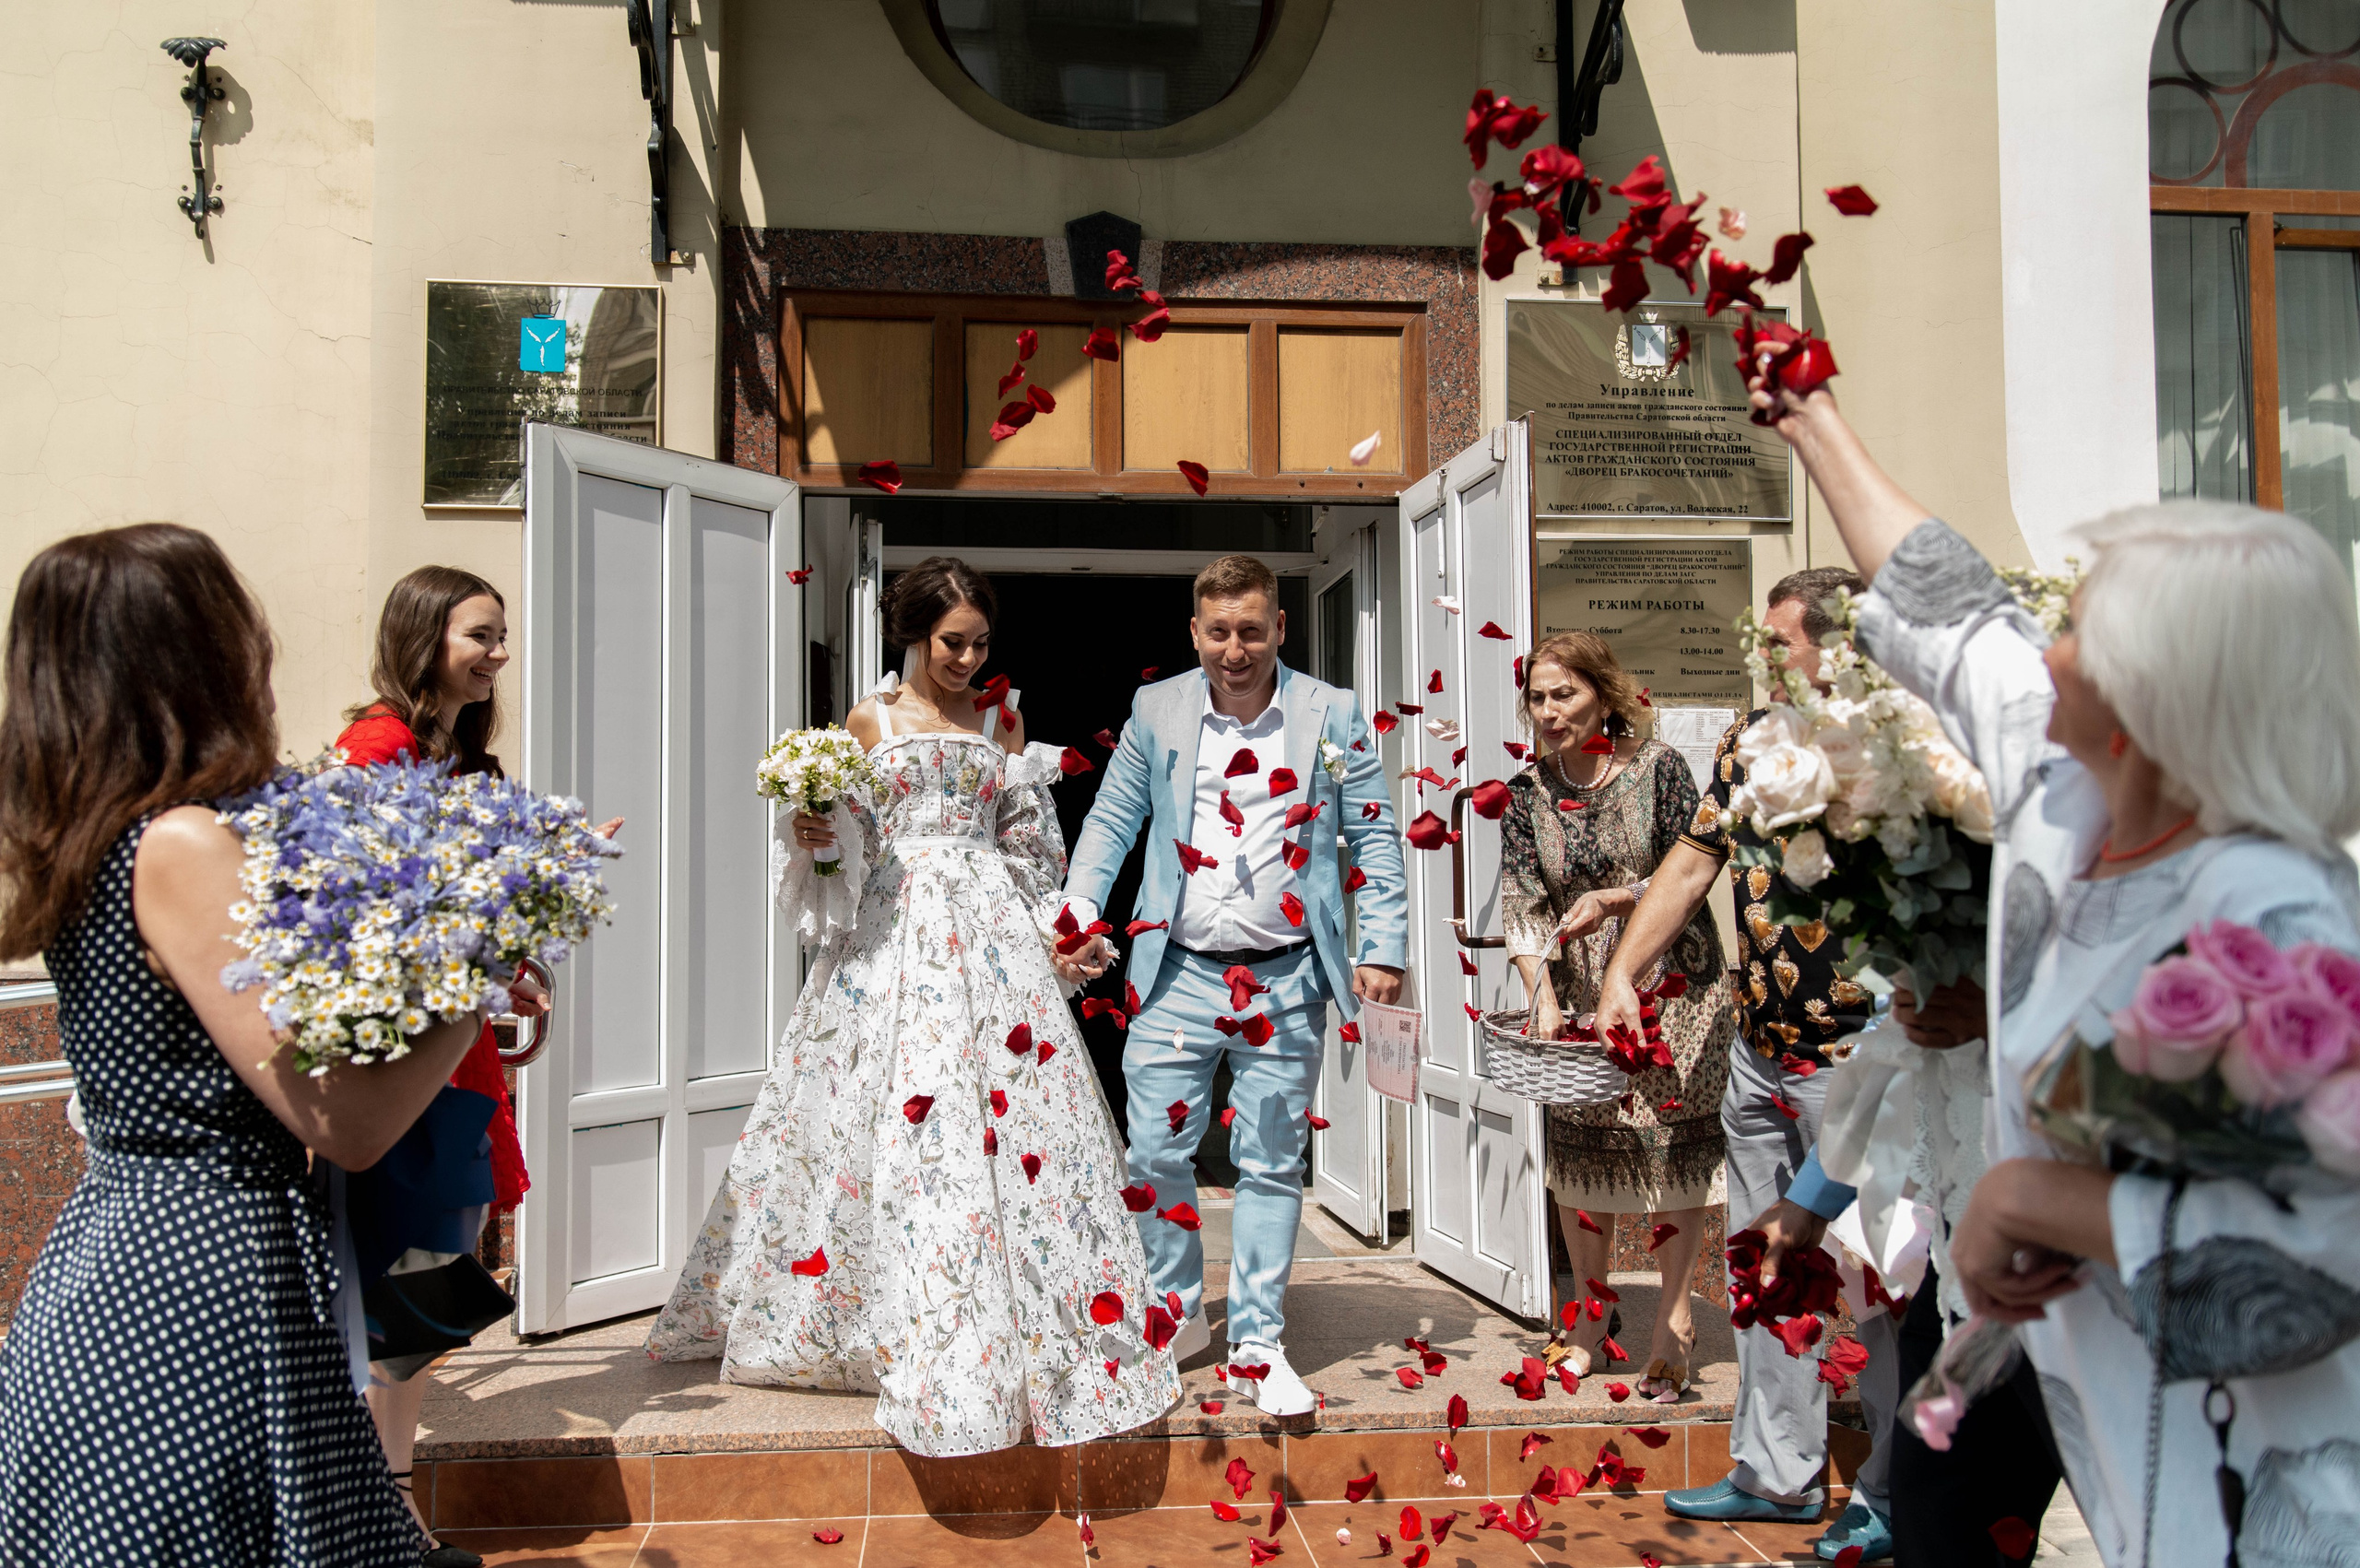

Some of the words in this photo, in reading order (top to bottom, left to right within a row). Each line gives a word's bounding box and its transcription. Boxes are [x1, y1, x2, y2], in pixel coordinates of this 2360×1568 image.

[443, 385, 525, 395] ПРАВИТЕЛЬСТВО
[526, 386, 596, 396] САРАТОВСКОЙ
[597, 387, 643, 397] ОБЛАСТИ
[1600, 383, 1694, 398] Управление
[457, 406, 526, 417] Управление
[1644, 404, 1703, 412] гражданского
[1568, 412, 1634, 421] Правительства
[1635, 413, 1691, 422] Саратовской
[1693, 413, 1726, 422] области
[1555, 430, 1702, 442] СПЕЦИАЛИЗИРОВАННЫЙ
[1704, 432, 1742, 442] ОТДЕЛ
[1550, 442, 1666, 453] ГОСУДАРСТВЕННОЙ
[1670, 444, 1752, 454] РЕГИСТРАЦИИ
[1545, 454, 1584, 464] АКТОВ
[1587, 455, 1682, 466] ГРАЖДАНСКОГО
[1684, 456, 1756, 466] СОСТОЯНИЯ
[1565, 466, 1618, 477] «ДВОРЕЦ
[1620, 467, 1734, 478] БРАКОСОЧЕТАНИЙ»
[1547, 502, 1578, 513] Адрес:
[1581, 503, 1615, 513] 410002,
[1626, 504, 1669, 513] Саратов,
[1687, 504, 1736, 514] Волжская,
[1738, 505, 1749, 513] 22
[1634, 577, 1683, 585] САРАТОВСКОЙ
[1588, 599, 1643, 610] РЕЖИМ
[1646, 600, 1705, 610] РАБОТЫ
[1680, 647, 1725, 655] 13.00-14.00
[1680, 667, 1724, 676] Выходные
